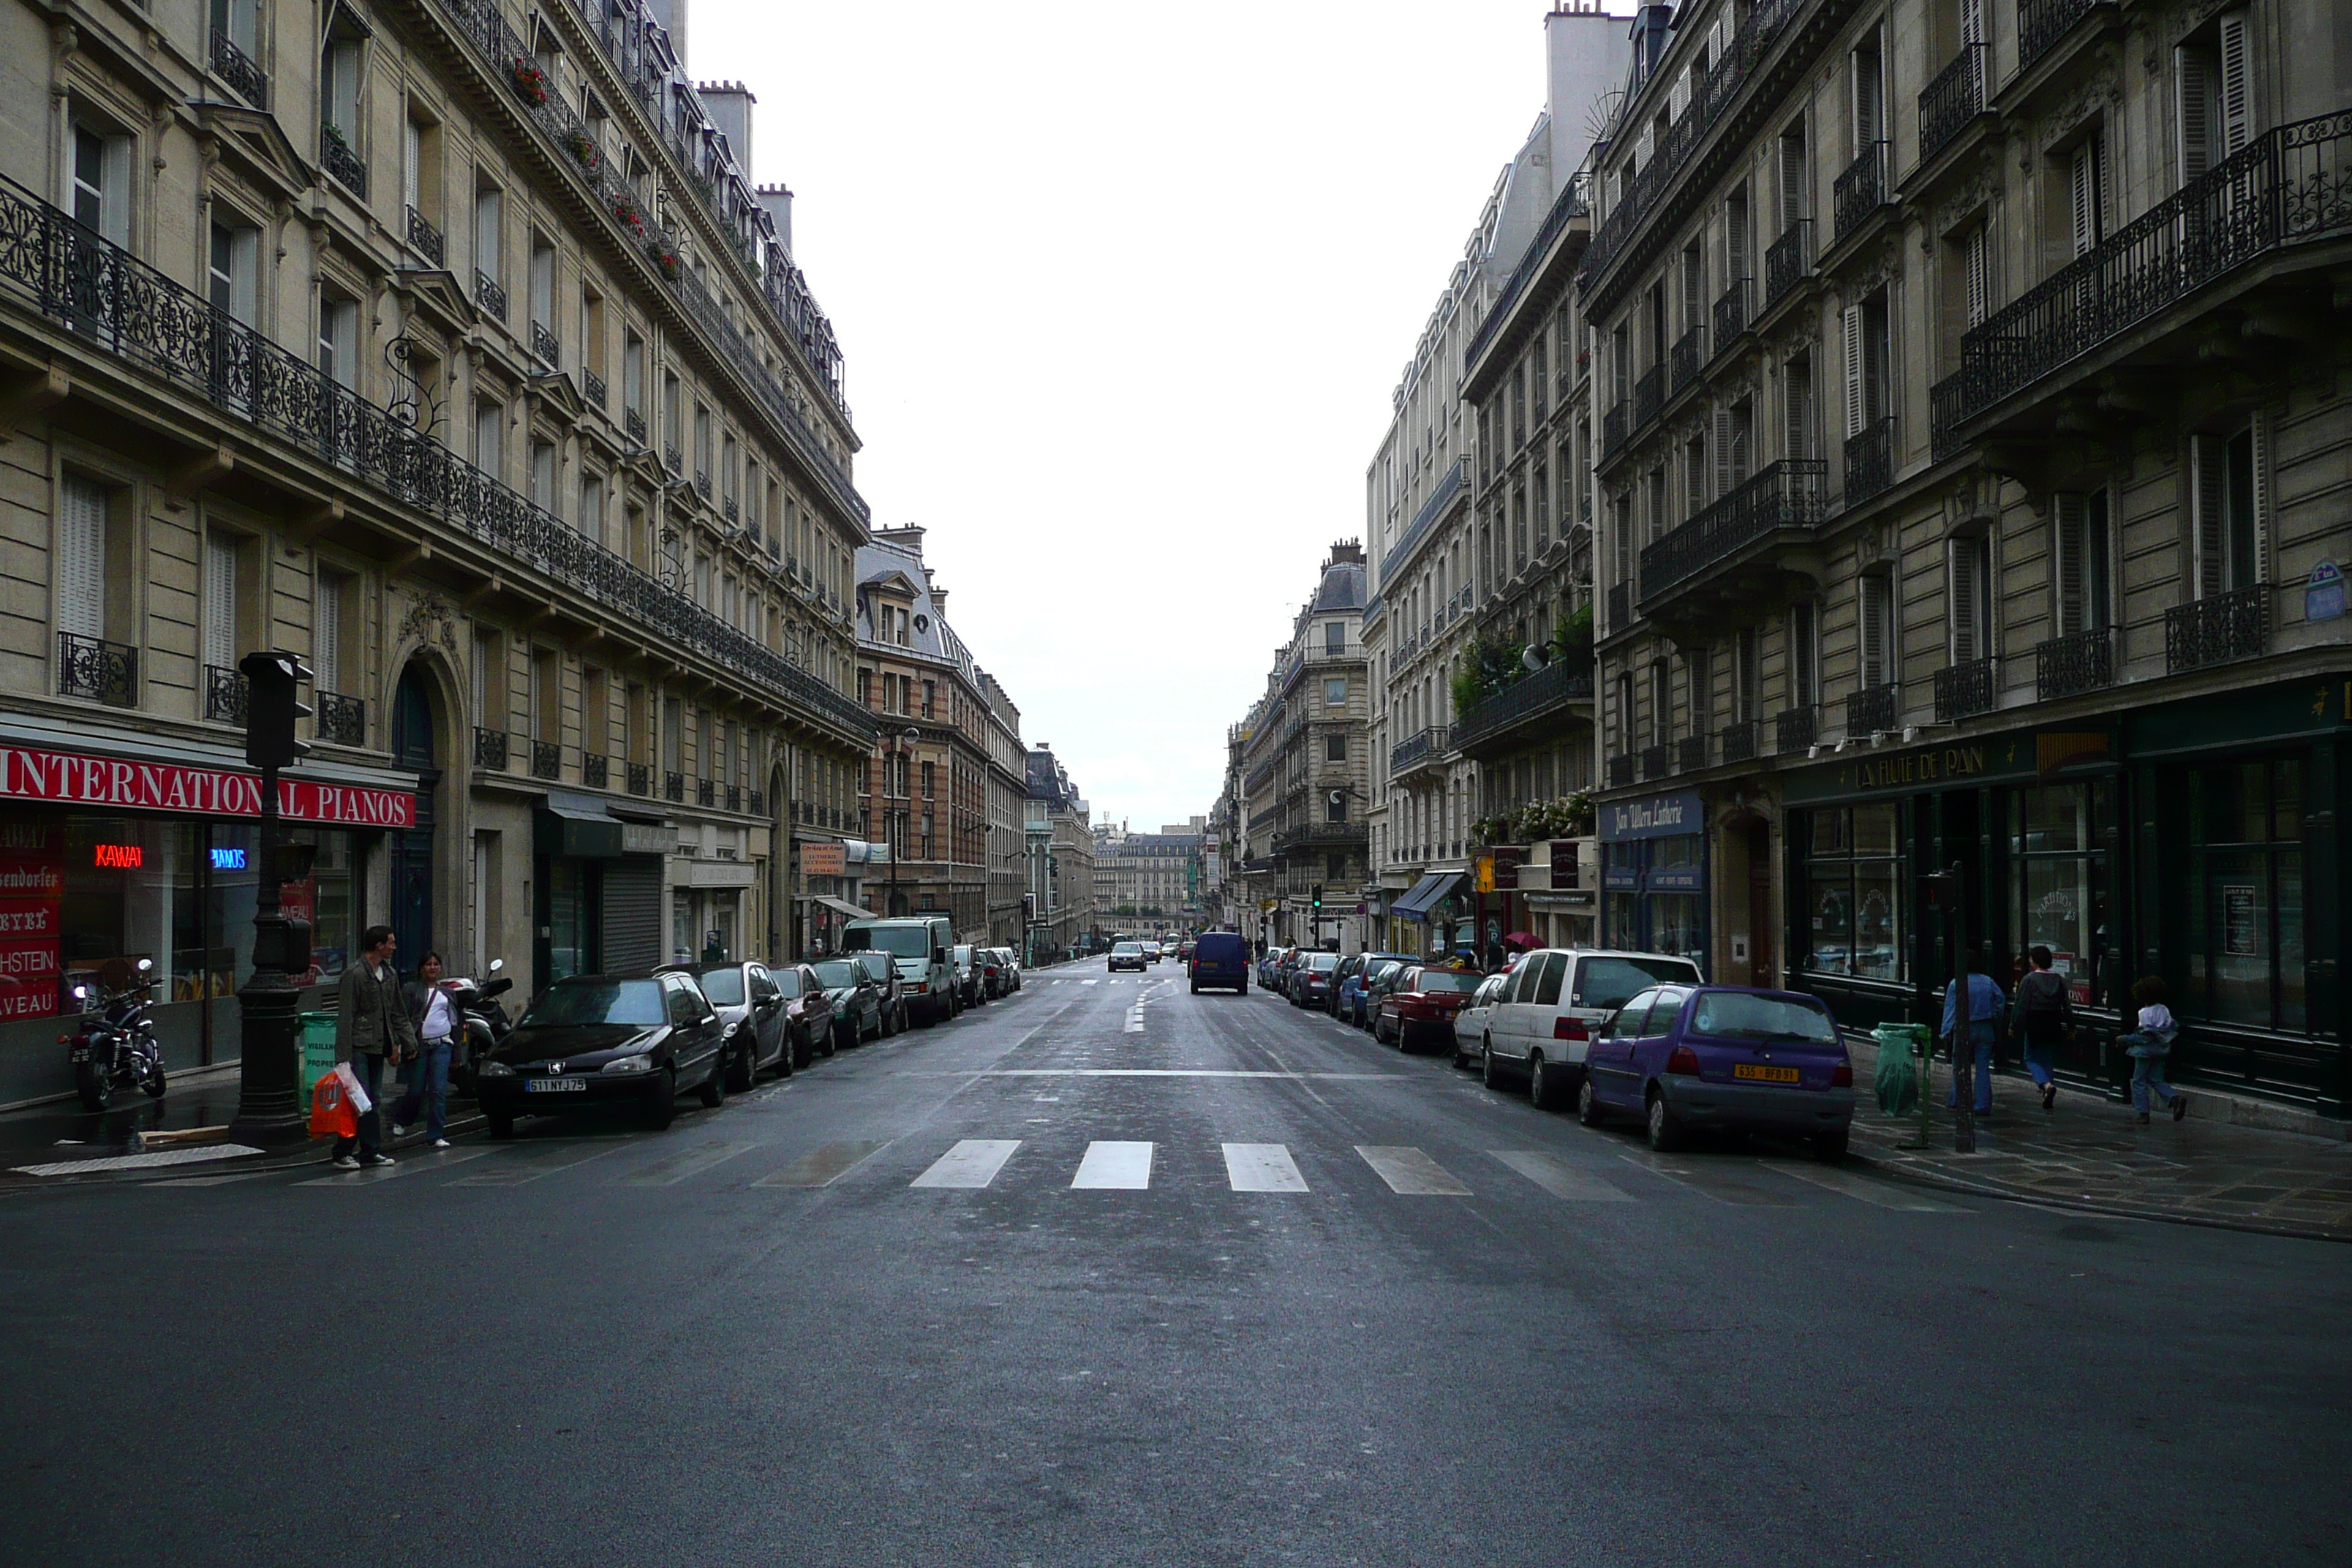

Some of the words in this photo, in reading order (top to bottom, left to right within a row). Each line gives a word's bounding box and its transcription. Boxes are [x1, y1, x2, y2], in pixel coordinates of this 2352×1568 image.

[1855, 764, 1876, 789] LA
[1879, 756, 1913, 785] FLUTE
[1920, 752, 1937, 780] DE
[1946, 746, 1983, 777] PAN
[317, 786, 405, 824] PIANOS
[1653, 799, 1683, 827] Lutherie
[96, 845, 142, 867] KAWAI
[1490, 932, 1499, 941] P
[0, 950, 54, 973] HSTEIN
[1739, 1066, 1756, 1077] 635
[1765, 1068, 1781, 1079] BFD
[1784, 1068, 1793, 1079] 91
[531, 1081, 548, 1090] 611
[551, 1080, 569, 1090] NYJ
[571, 1079, 584, 1090] 75
